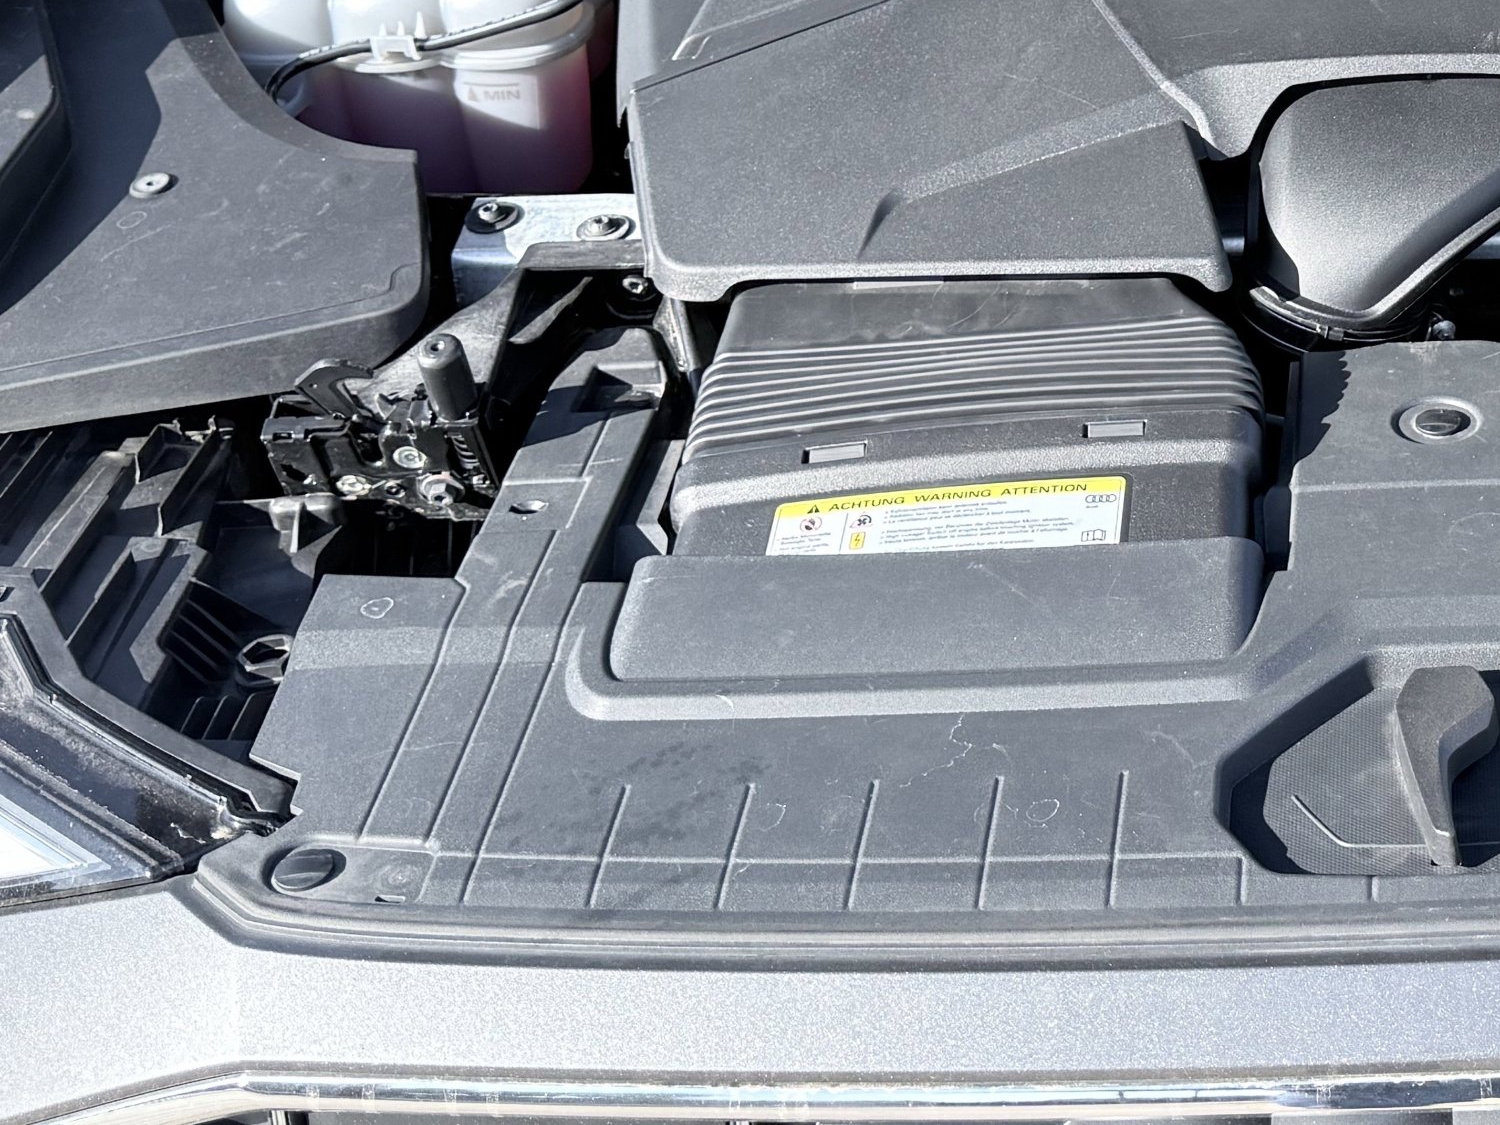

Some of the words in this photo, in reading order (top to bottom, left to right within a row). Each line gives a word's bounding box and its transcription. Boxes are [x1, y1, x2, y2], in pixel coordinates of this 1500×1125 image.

[484, 89, 521, 100] MIN
[828, 497, 905, 512] ACHTUNG
[914, 488, 992, 503] WARNING
[1000, 483, 1088, 496] ATTENTION
